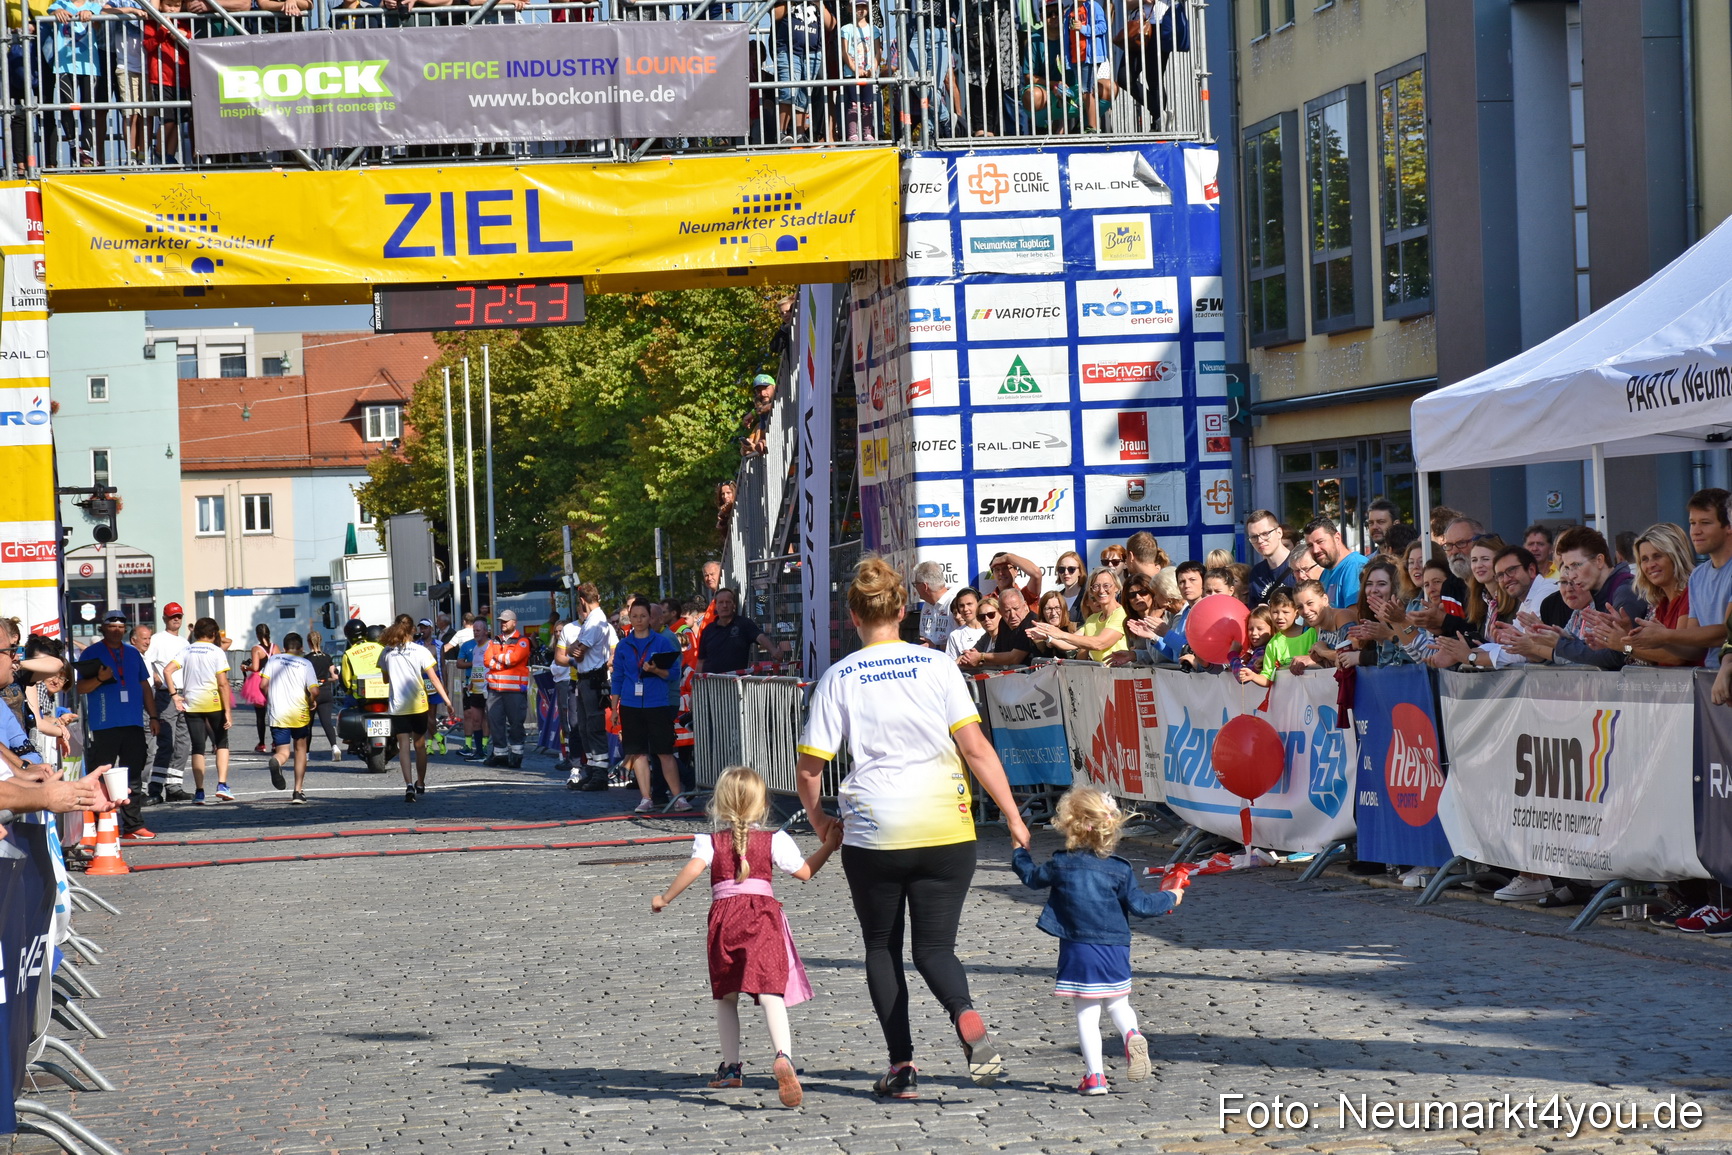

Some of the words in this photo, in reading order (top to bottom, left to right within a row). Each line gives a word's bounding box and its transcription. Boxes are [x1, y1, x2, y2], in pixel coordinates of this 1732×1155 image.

[423, 60, 500, 81] OFFICE
[506, 57, 619, 79] INDUSTRY
[625, 55, 718, 76] LOUNGE
[222, 64, 385, 99] BOCK
[468, 84, 676, 108] www.bockonline.de
[219, 104, 273, 119] inspired
[276, 104, 292, 118] by
[296, 101, 334, 115] smart
[336, 100, 396, 114] concepts
[1013, 172, 1043, 182] CODE
[1014, 181, 1049, 193] CLINIC
[1074, 179, 1140, 191] RAIL.ONE
[25, 218, 44, 232] Bra
[383, 189, 573, 259] ZIEL
[678, 215, 775, 235] Neumarkter
[779, 209, 856, 229] Stadtlauf
[90, 235, 191, 250] Neumarkter
[196, 234, 275, 250] Stadtlauf
[973, 239, 1018, 251] Neumarkter
[1018, 237, 1051, 251] Tagblatt
[1105, 231, 1142, 252] Burgis
[454, 282, 569, 326] 32:53
[995, 306, 1061, 319] VARIOTEC
[1130, 315, 1174, 325] energie
[909, 321, 952, 333] energie
[1086, 361, 1152, 378] charivari
[1626, 367, 1681, 413] PARTL
[1681, 361, 1732, 404] Neum
[977, 440, 1041, 451] RAIL.ONE
[1119, 438, 1147, 451] Braun
[979, 496, 1039, 515] swn
[1113, 504, 1162, 513] Neumarkter
[918, 516, 960, 528] energie
[979, 514, 1019, 523] stadtwerke
[1020, 512, 1055, 521] neumarkt
[1105, 511, 1170, 525] Lammsbräu
[351, 644, 376, 657] HELFER
[838, 665, 857, 679] 20.
[857, 654, 932, 670] Neumarkter
[859, 667, 918, 685] Stadtlauf
[371, 720, 382, 728] NM
[373, 728, 383, 736] PC
[1389, 728, 1444, 802] Hervis
[1514, 733, 1584, 801] swn
[1512, 805, 1563, 832] stadtwerke
[1564, 812, 1603, 837] neumarkt
